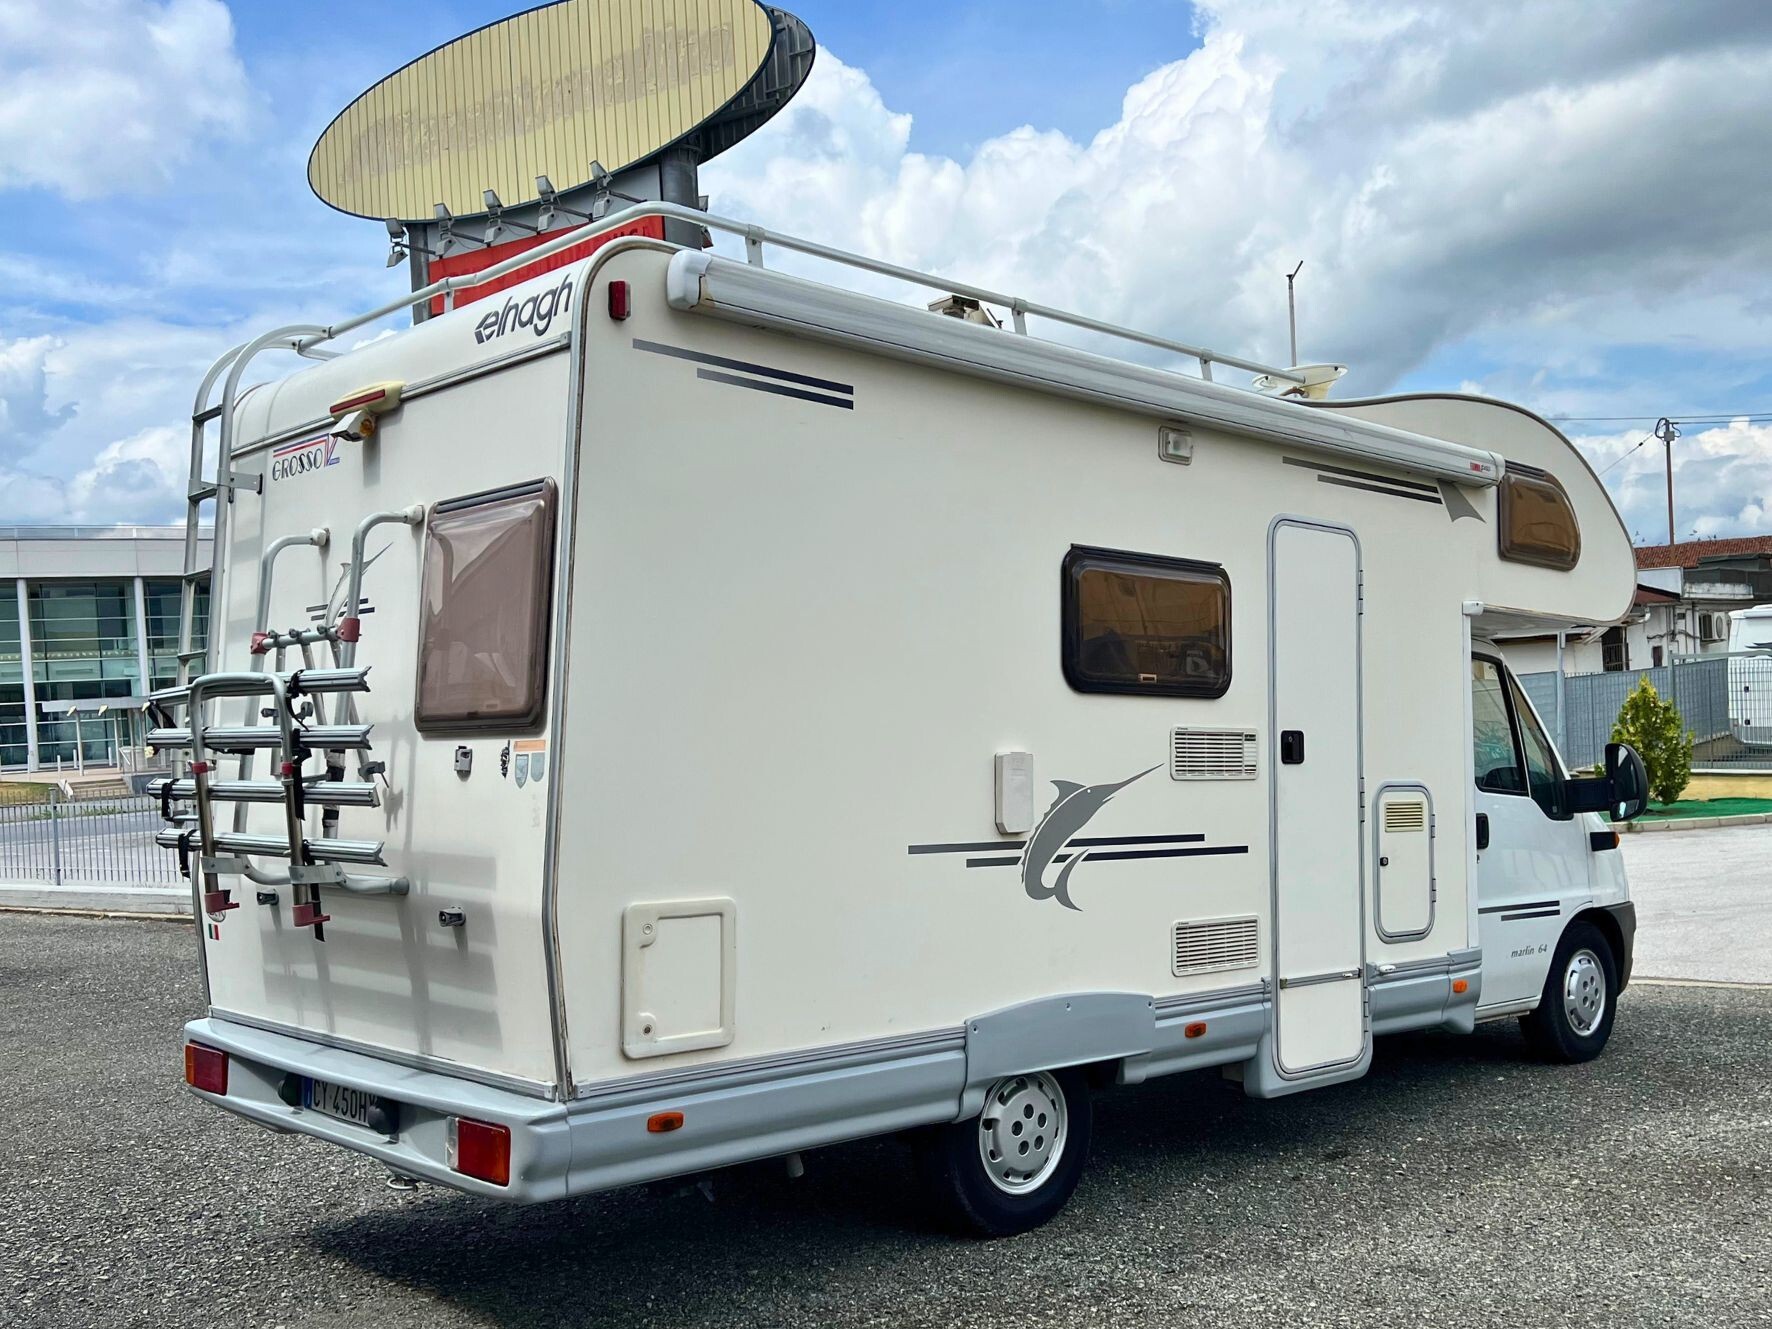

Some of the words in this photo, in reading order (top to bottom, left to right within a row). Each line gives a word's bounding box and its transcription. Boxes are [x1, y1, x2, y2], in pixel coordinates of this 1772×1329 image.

[474, 272, 573, 344] elnagh
[272, 448, 323, 481] GROSSO
[1510, 945, 1535, 958] marlin
[1538, 944, 1548, 954] 64
[313, 1079, 329, 1110] CY
